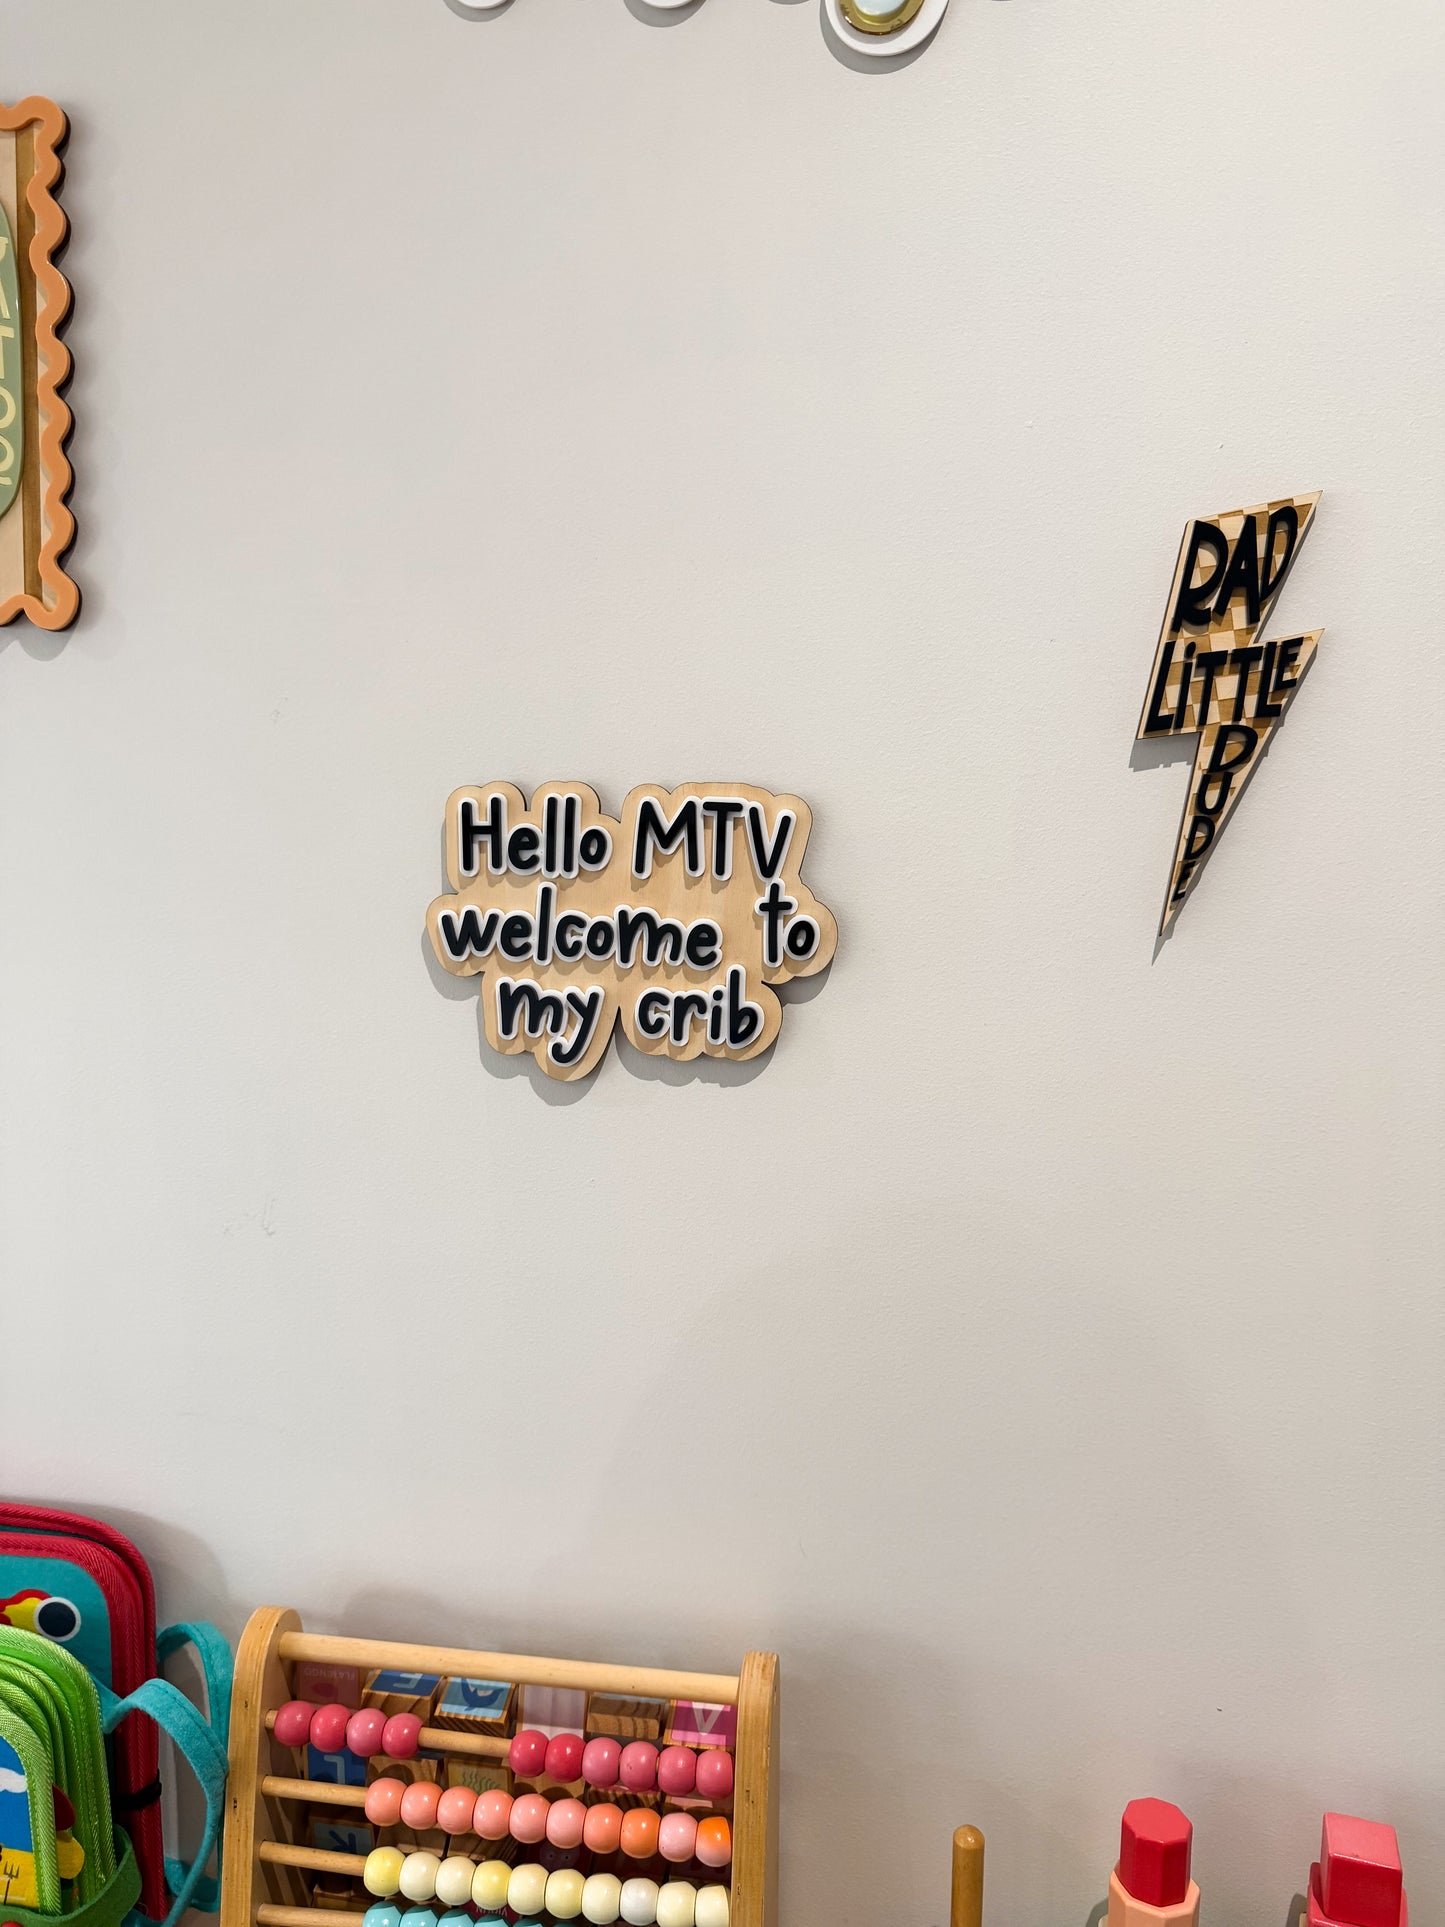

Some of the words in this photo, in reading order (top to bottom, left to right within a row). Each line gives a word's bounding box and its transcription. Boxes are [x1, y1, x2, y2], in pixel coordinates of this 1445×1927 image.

[1172, 505, 1299, 631] RAD
[460, 795, 608, 873] Hello
[633, 799, 792, 880] MTV
[1171, 724, 1259, 902] DUDE
[441, 885, 720, 968] welcome
[758, 882, 817, 964] to
[499, 980, 600, 1064] my
[638, 968, 760, 1045] crib
